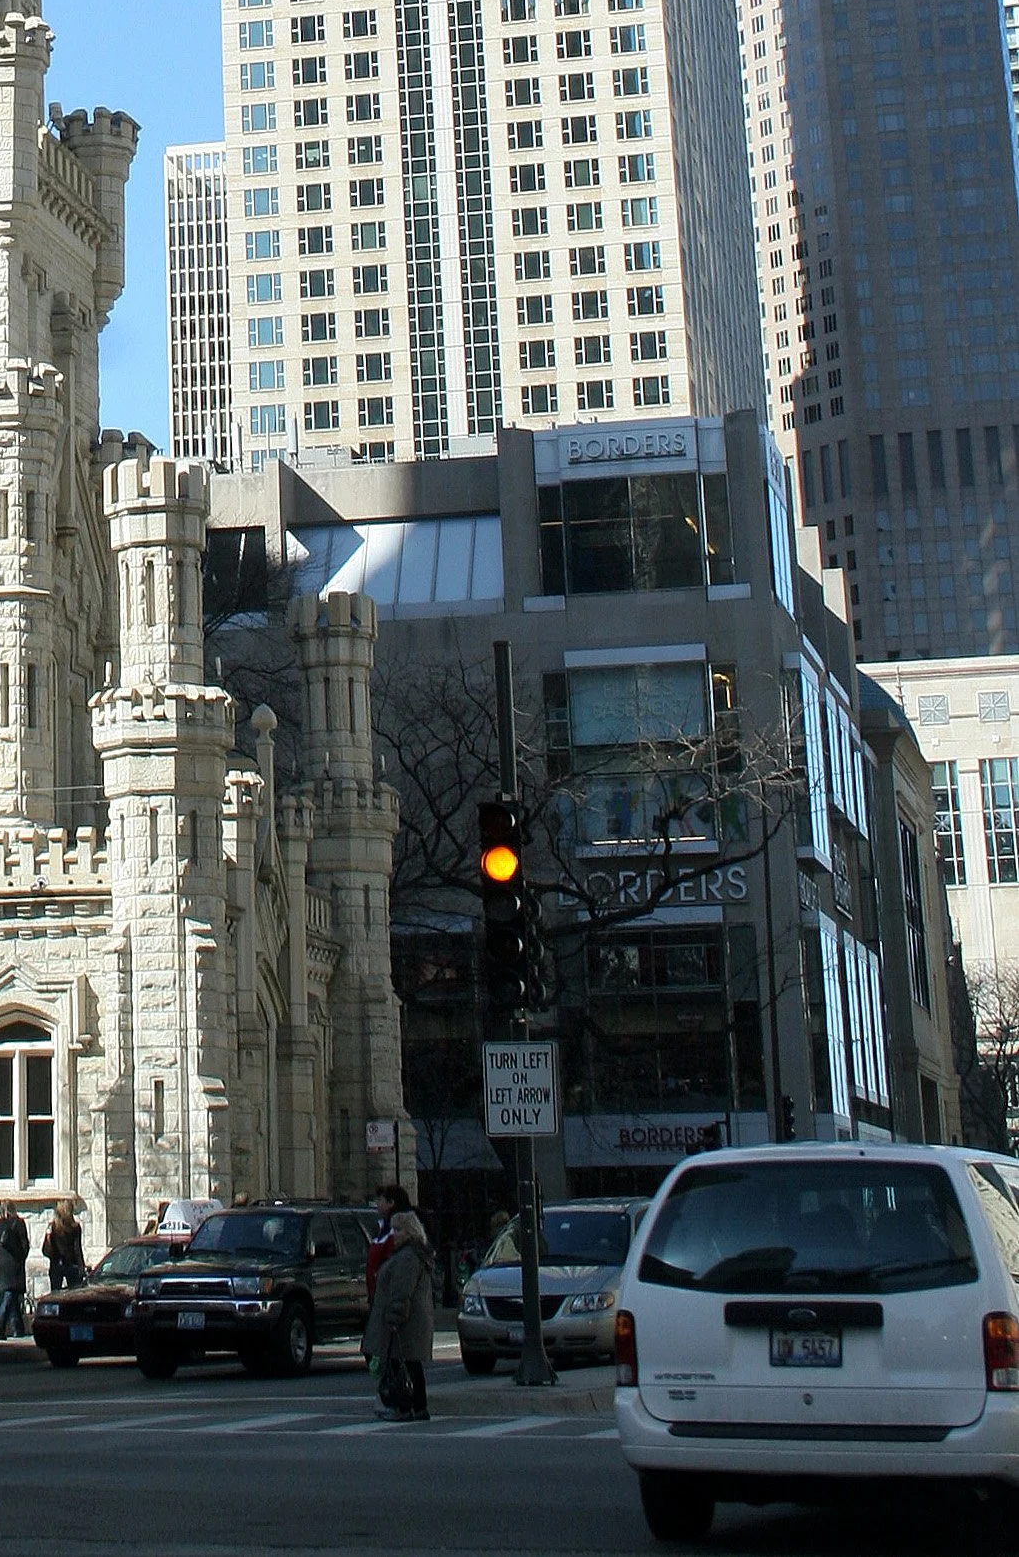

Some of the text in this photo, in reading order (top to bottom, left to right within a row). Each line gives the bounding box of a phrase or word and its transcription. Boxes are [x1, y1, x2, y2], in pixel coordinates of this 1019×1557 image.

[568, 432, 686, 460] BORDERS
[558, 865, 748, 907] BORDERS
[488, 1052, 549, 1069] TURN LEFT
[512, 1072, 528, 1084] ON
[490, 1087, 551, 1104] LEFT ARROW
[500, 1108, 541, 1125] ONLY
[619, 1125, 707, 1144] BORDERS
